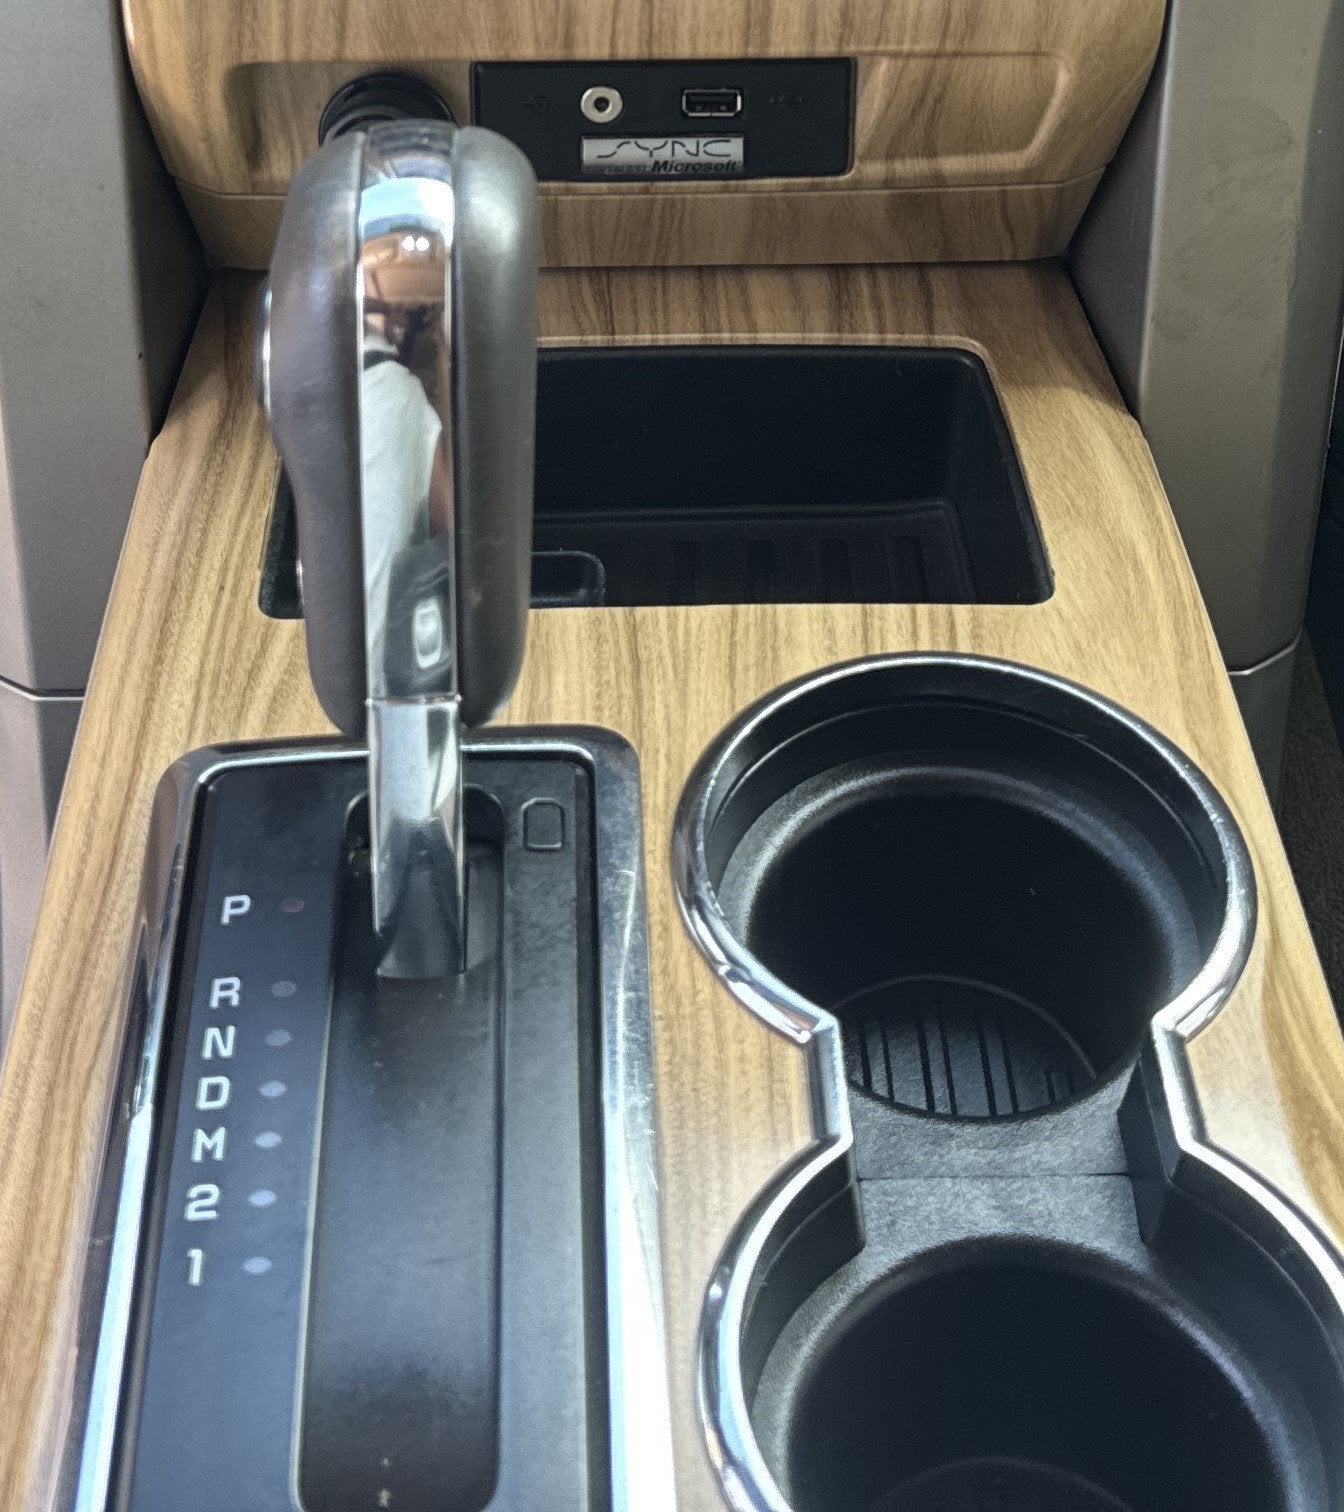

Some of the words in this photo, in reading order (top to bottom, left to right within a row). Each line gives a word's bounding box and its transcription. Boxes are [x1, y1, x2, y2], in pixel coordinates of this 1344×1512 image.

[596, 139, 732, 159] SYNC
[652, 159, 737, 174] Microsoft
[220, 894, 251, 924] P
[210, 976, 241, 1008] R
[202, 1025, 236, 1060] N
[196, 1076, 231, 1110] D
[191, 1128, 226, 1163] M
[184, 1183, 220, 1221] 2
[187, 1247, 205, 1287] 1
